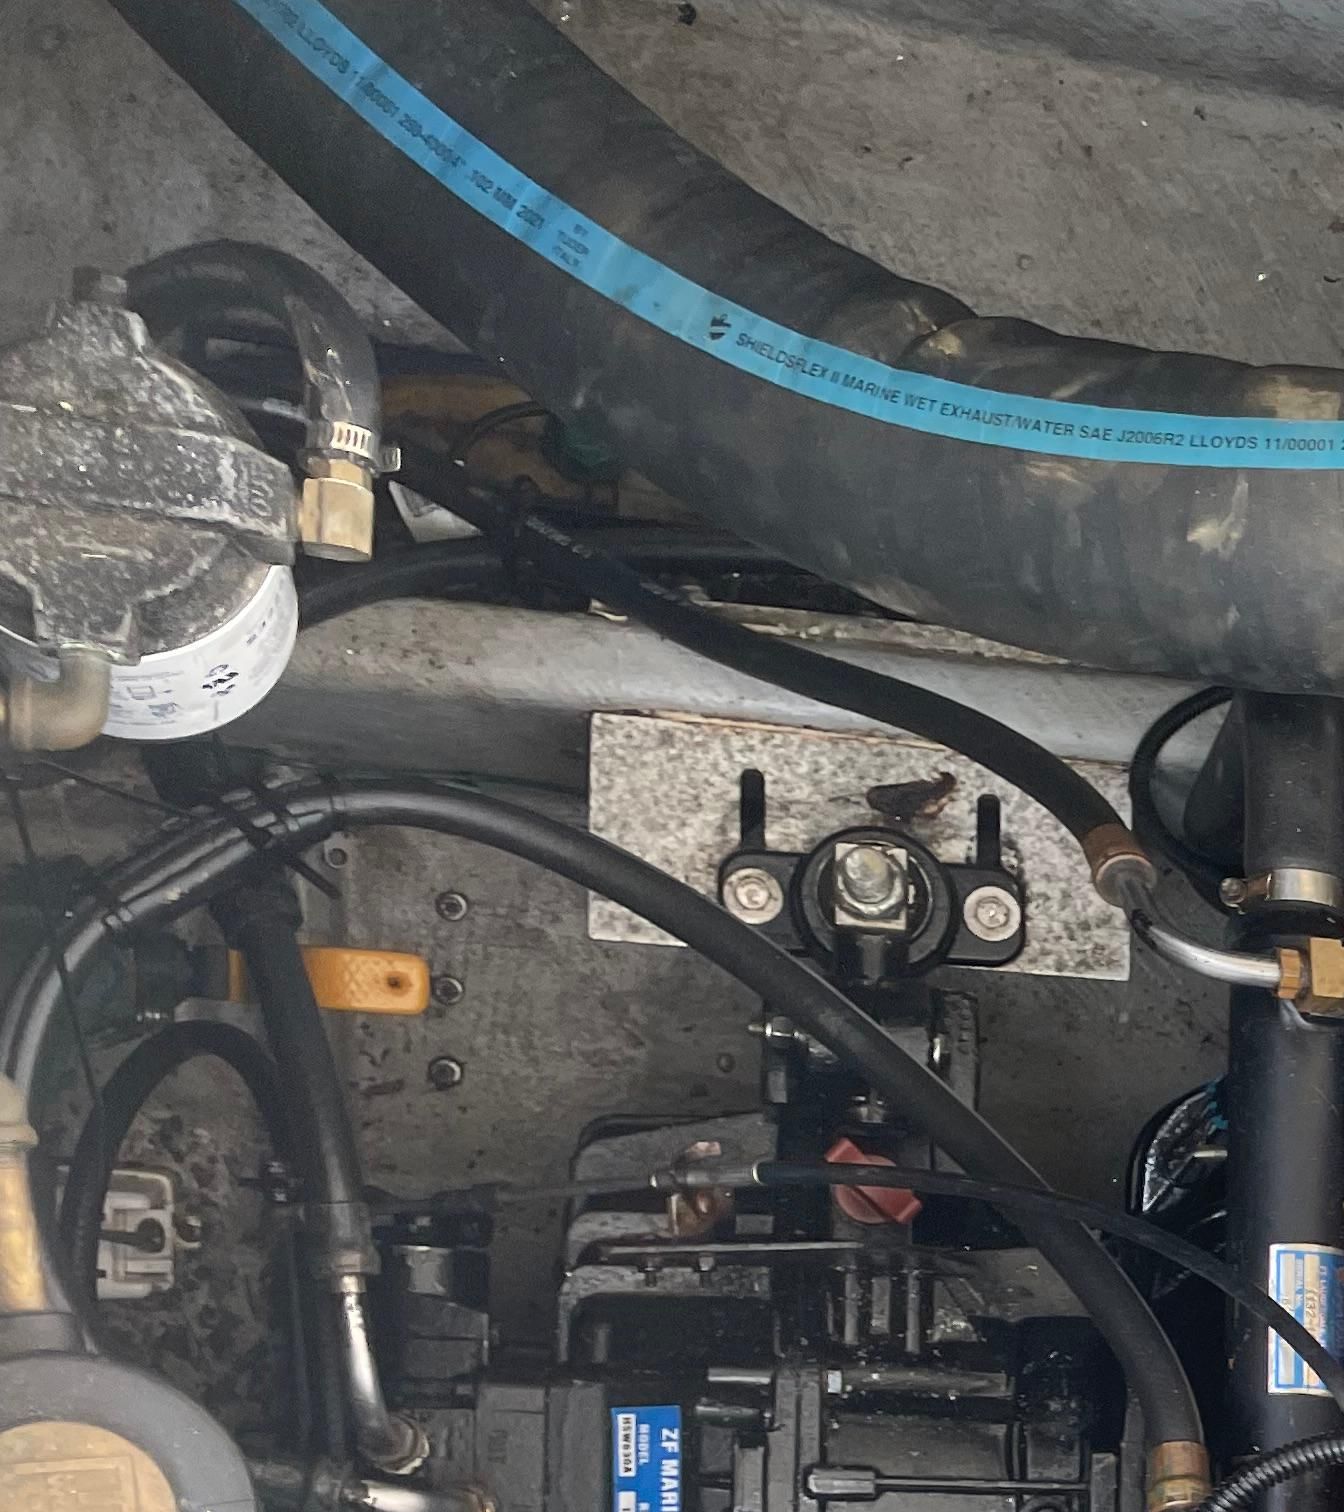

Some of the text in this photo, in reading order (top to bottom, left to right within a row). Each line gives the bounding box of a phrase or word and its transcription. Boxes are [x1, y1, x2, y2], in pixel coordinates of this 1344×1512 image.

[735, 331, 829, 380] SHIELDSFLEX
[840, 373, 902, 404] MARINE
[904, 393, 937, 413] WET
[1079, 425, 1113, 442] SAE
[1116, 427, 1184, 447] J2006R2
[1189, 434, 1259, 450] LLOYDS
[1264, 436, 1335, 451] 11/00001
[637, 1423, 651, 1466] MODEL
[660, 1427, 680, 1453] ZF
